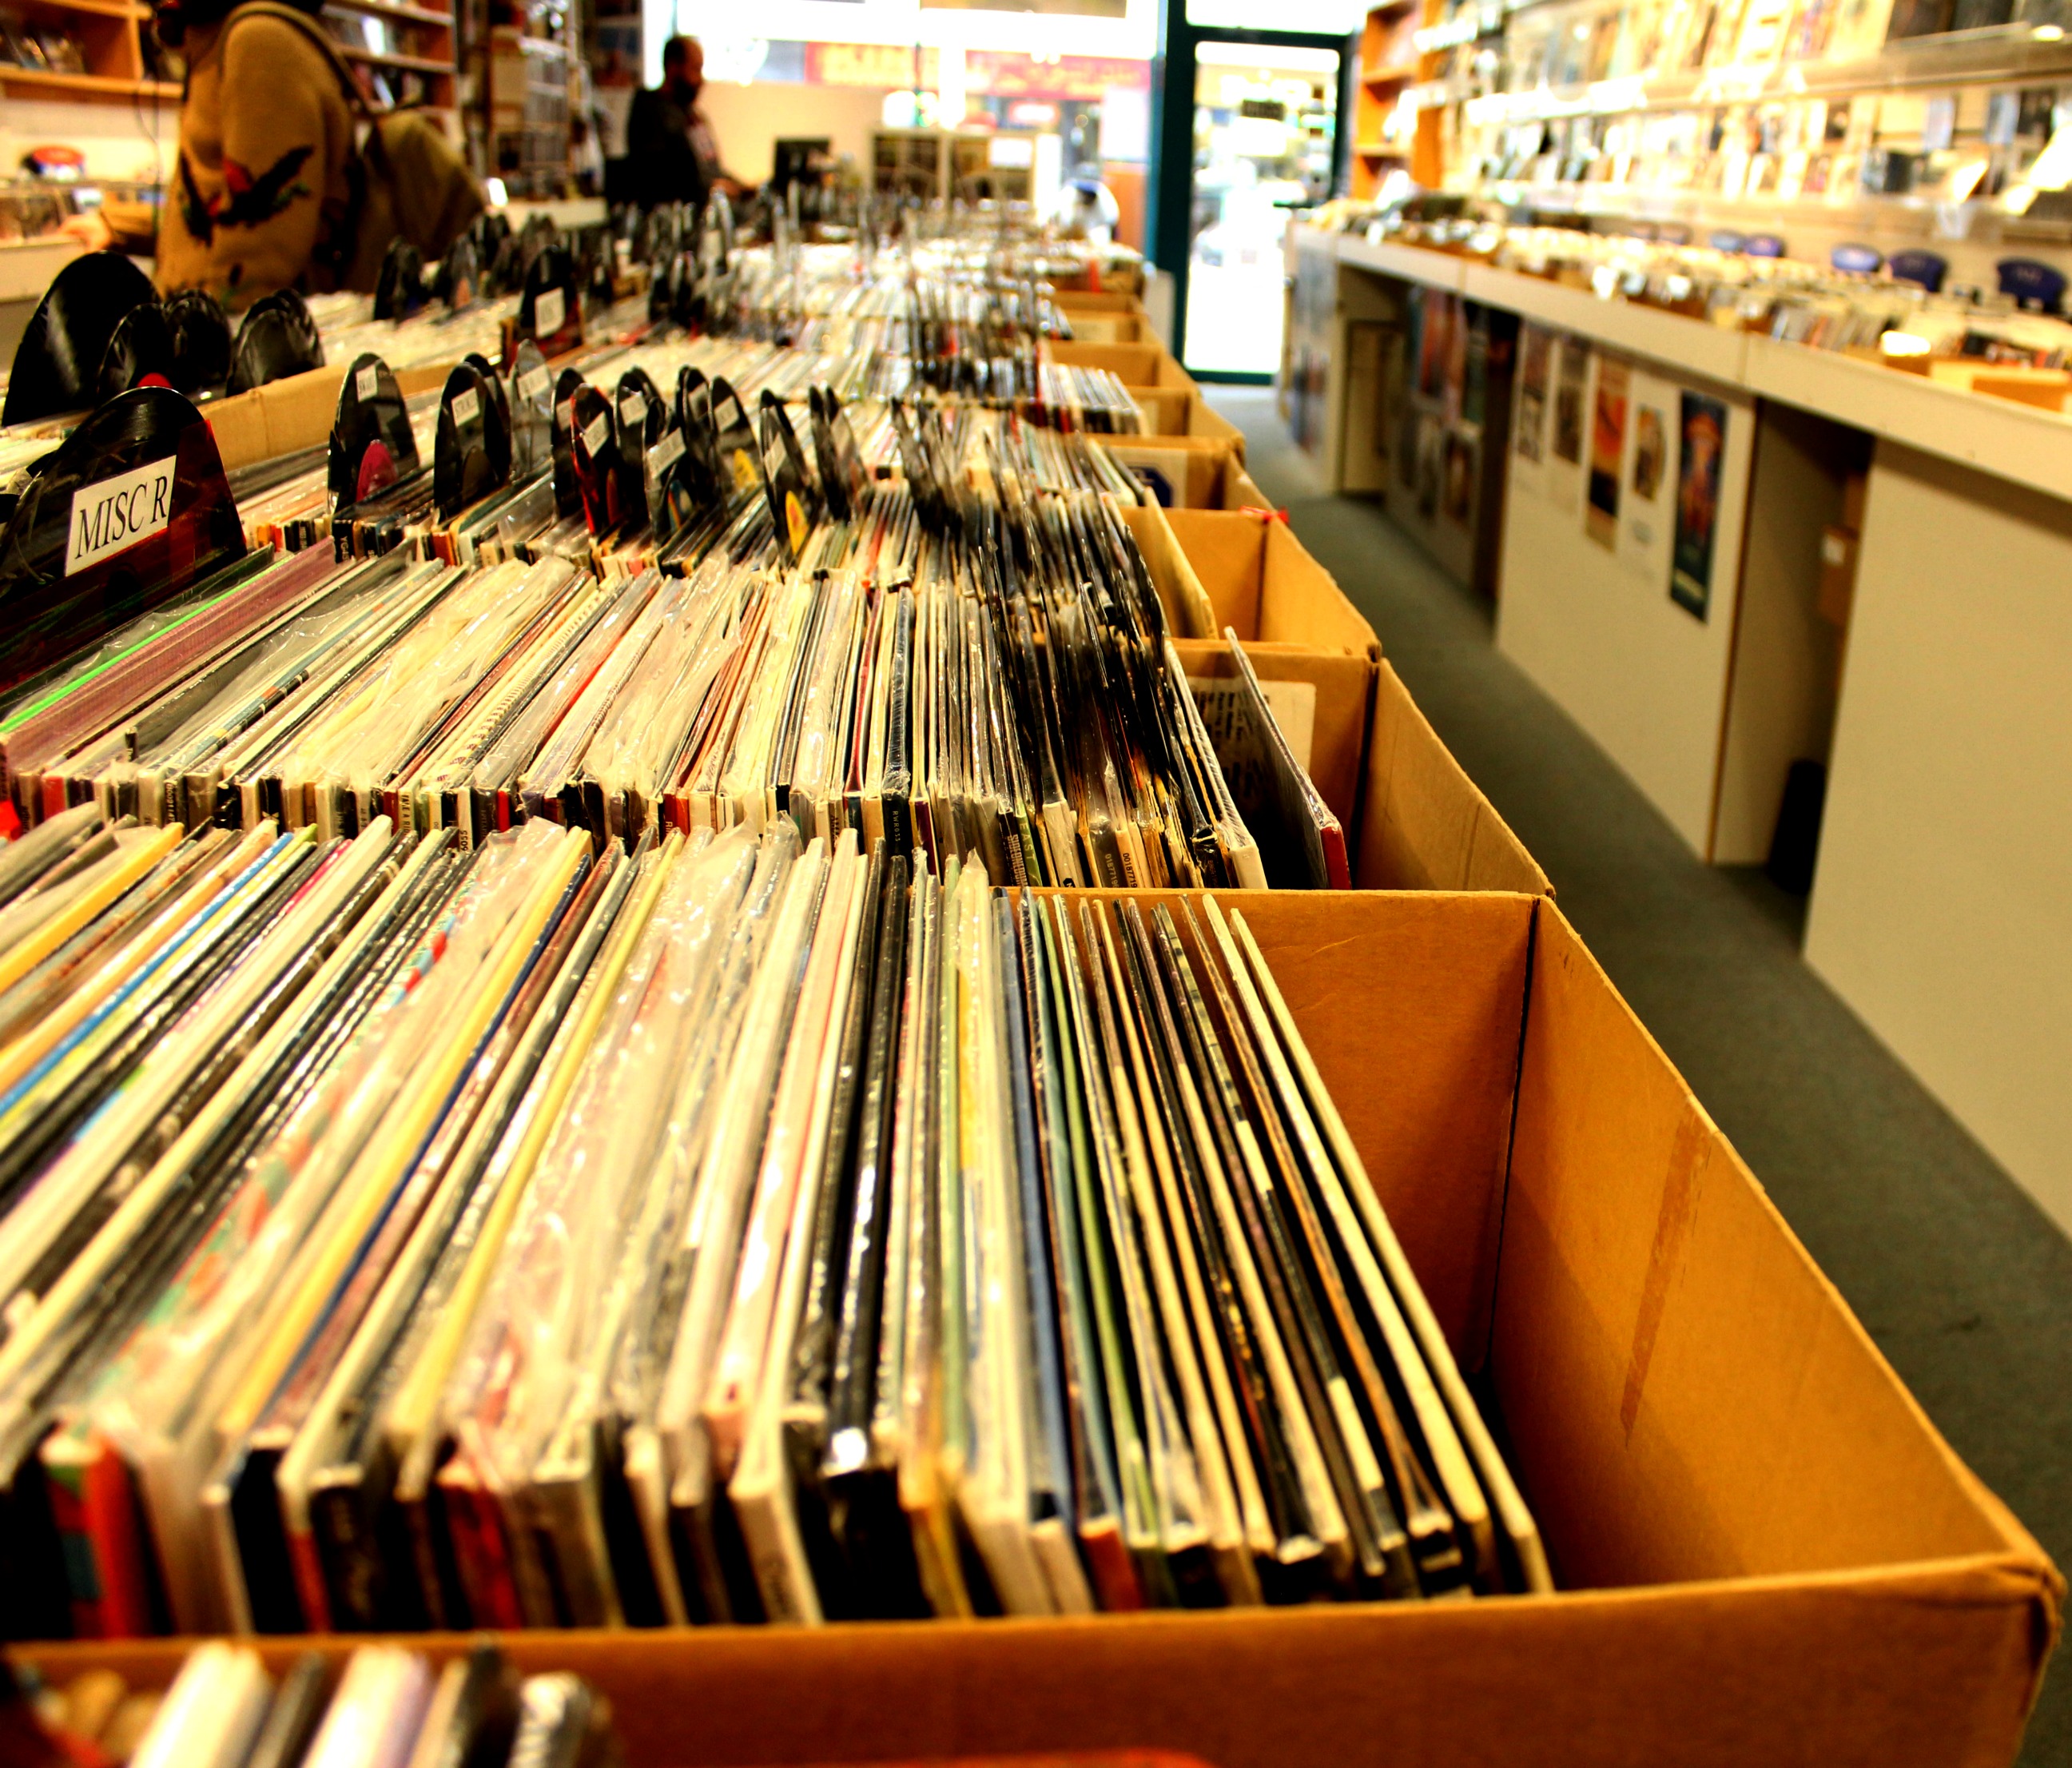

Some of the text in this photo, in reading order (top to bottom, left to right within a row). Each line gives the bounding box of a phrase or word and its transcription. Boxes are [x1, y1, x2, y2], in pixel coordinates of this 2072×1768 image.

[75, 476, 168, 559] MISC R
[1019, 822, 1035, 861] EAST
[1123, 853, 1138, 888] 00187719
